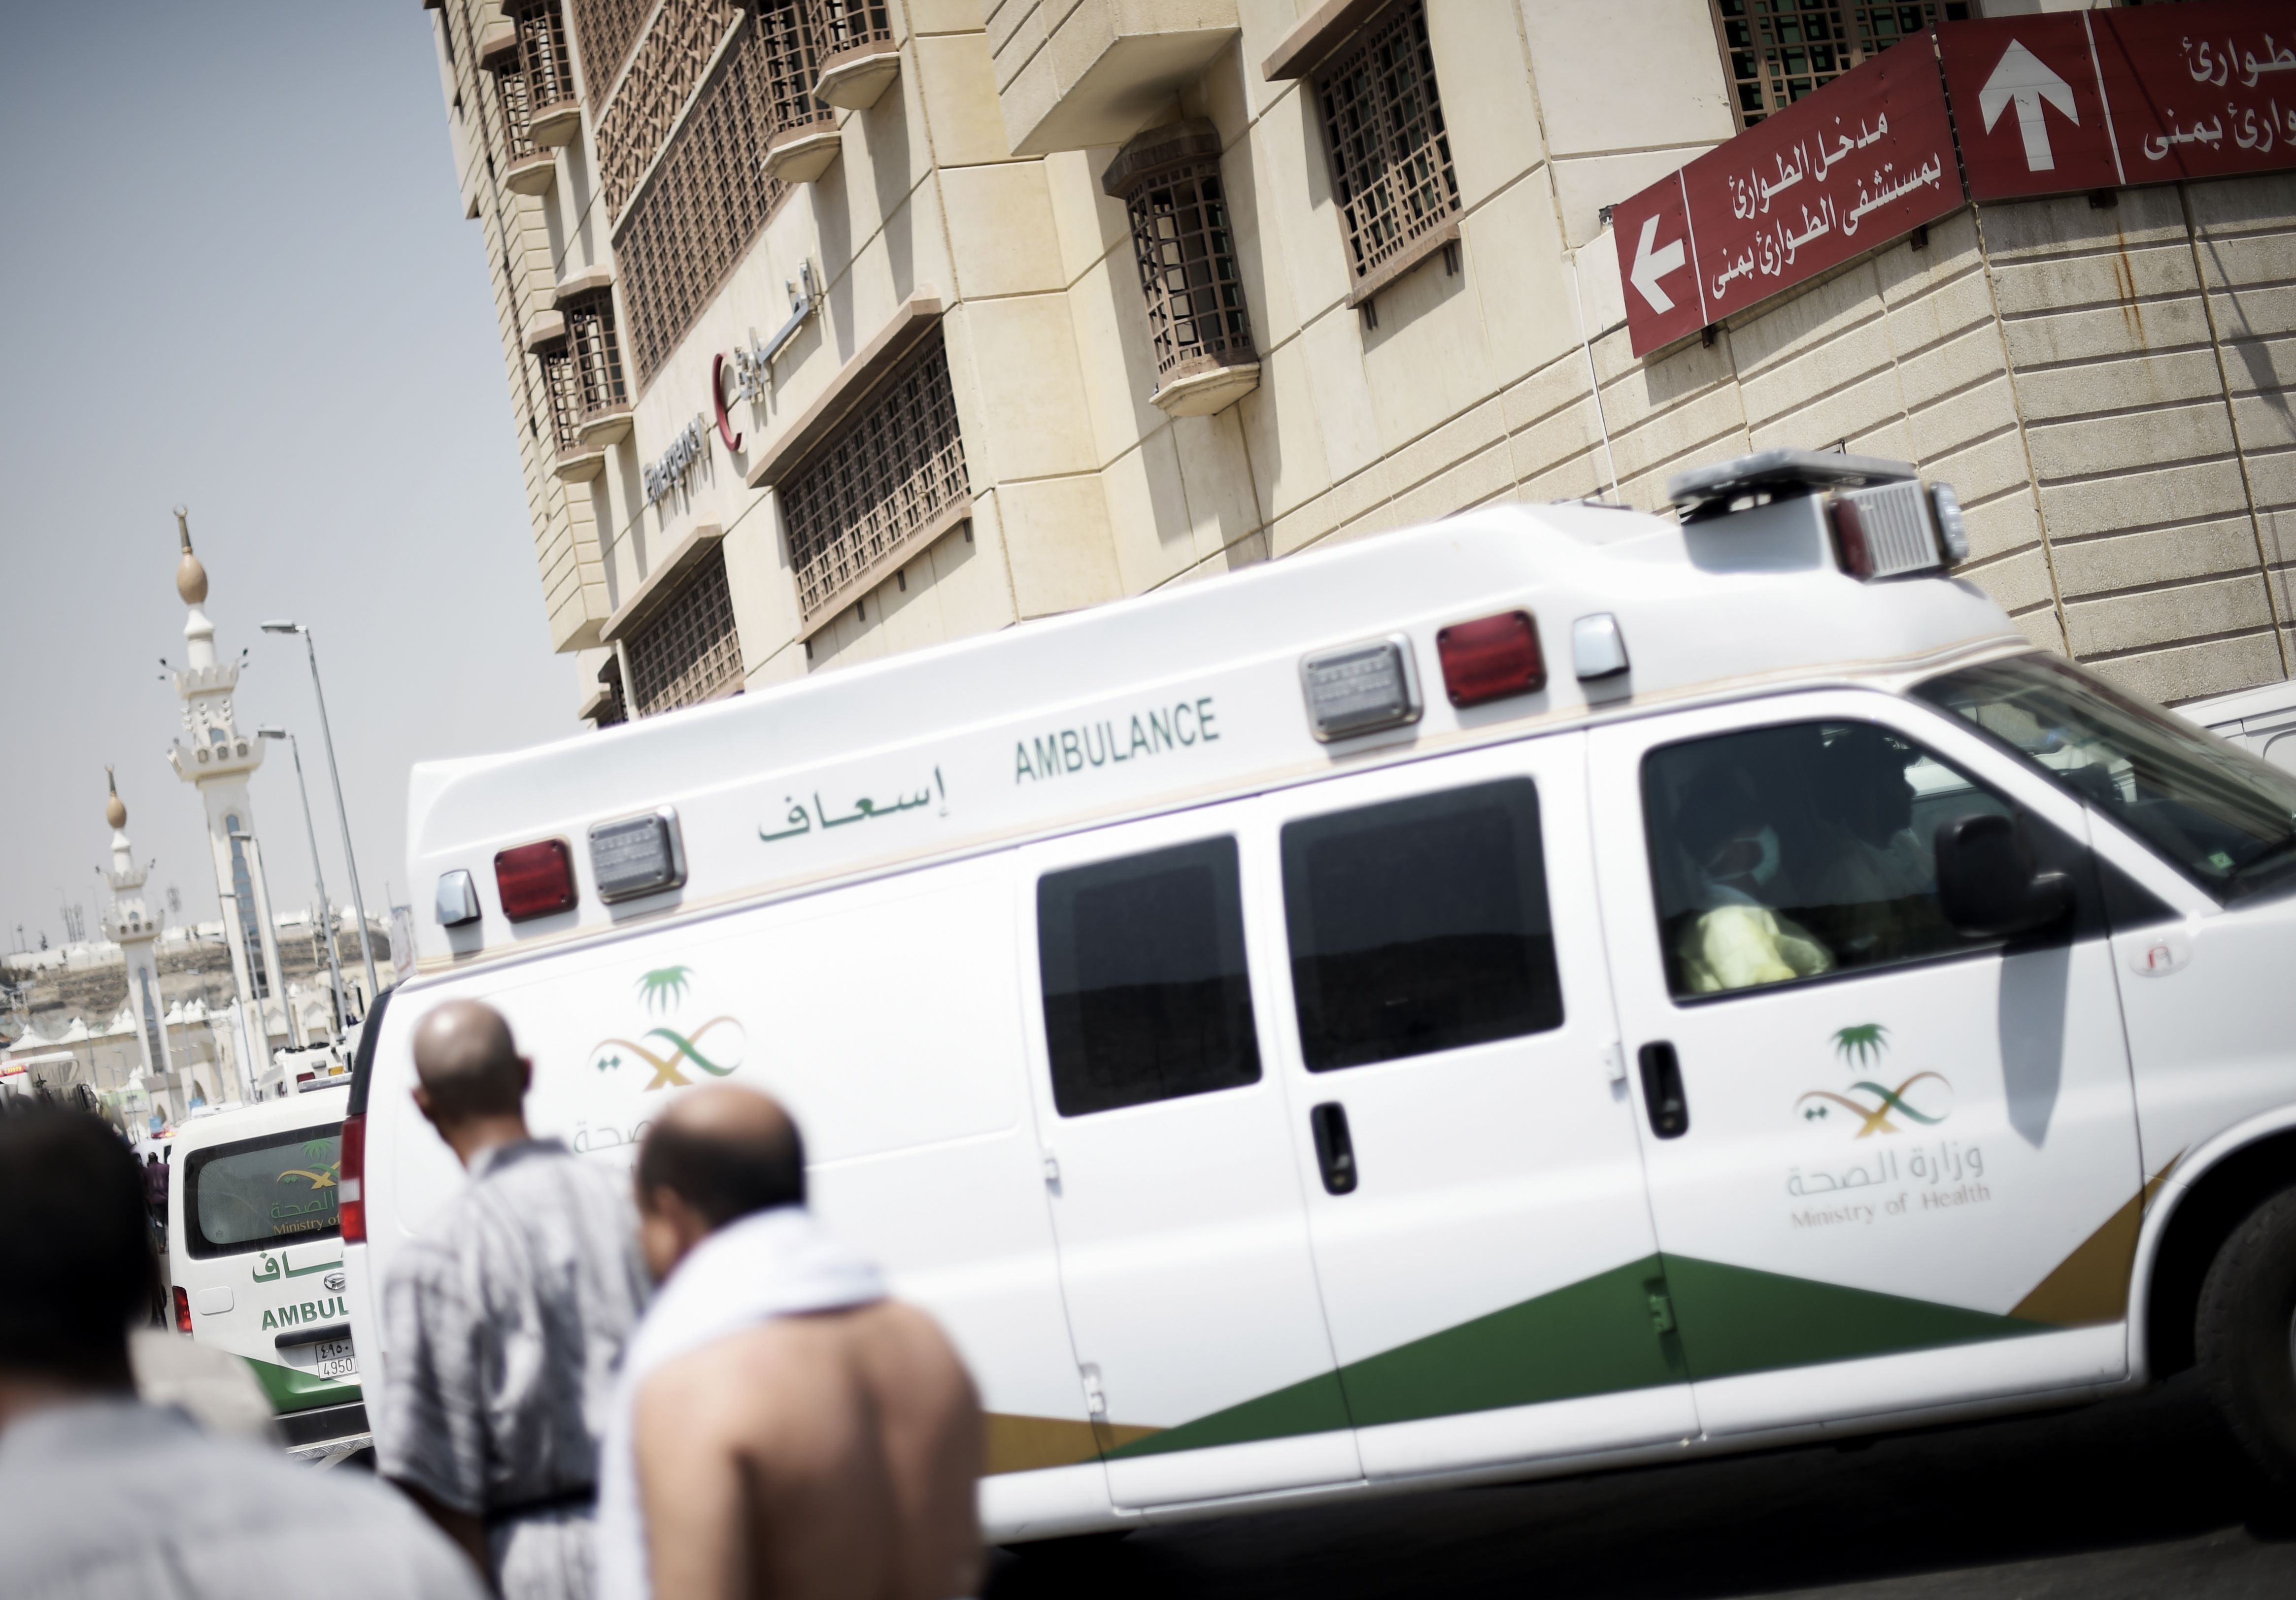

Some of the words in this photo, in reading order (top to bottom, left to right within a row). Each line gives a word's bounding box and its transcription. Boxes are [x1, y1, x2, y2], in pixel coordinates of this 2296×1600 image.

[2183, 33, 2296, 87] طوارئ
[1814, 111, 1888, 182] مدخل
[2144, 108, 2223, 160] بمنى
[1728, 139, 1810, 220] الطوارئ
[1843, 152, 1941, 236] بمستشفى
[1756, 193, 1837, 277] الطوارئ
[1712, 246, 1755, 300] بمنى
[1015, 697, 1220, 785] AMBULANCE
[759, 763, 949, 842] إسعاف
[1786, 1149, 1899, 1198] الصحة
[1910, 1139, 1985, 1186] وزارة
[271, 1190, 335, 1219] الصحة
[273, 1219, 324, 1235] Ministry
[328, 1213, 340, 1225] of
[1790, 1200, 1877, 1231] Ministry
[1885, 1193, 1909, 1216] of
[1922, 1183, 1992, 1211] Health
[324, 1358, 353, 1376] 4950
